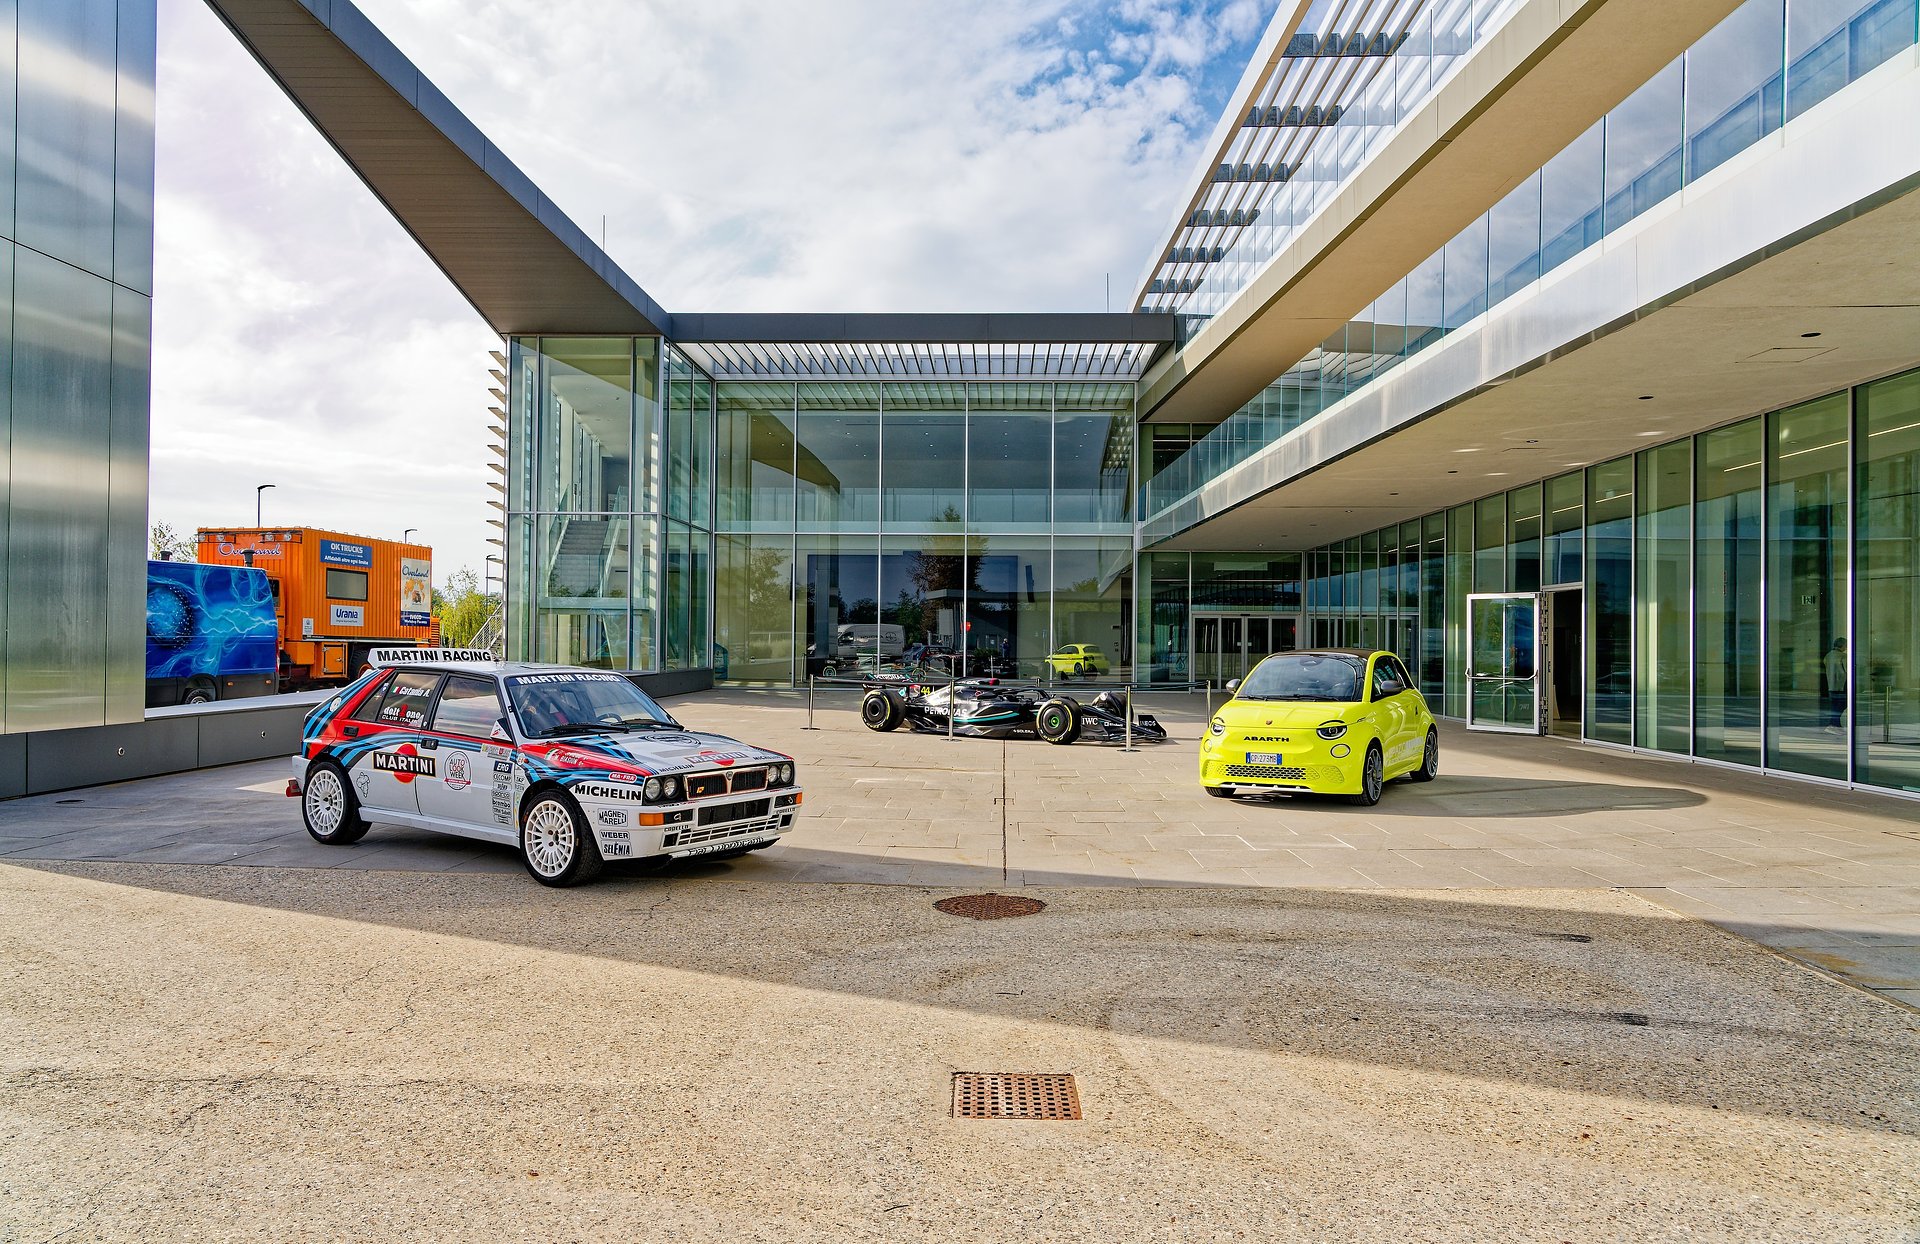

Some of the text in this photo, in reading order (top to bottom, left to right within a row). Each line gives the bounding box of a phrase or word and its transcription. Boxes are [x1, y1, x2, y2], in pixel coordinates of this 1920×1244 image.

[218, 542, 281, 557] Ovland
[330, 543, 363, 554] OK TRUCKS
[336, 608, 359, 619] Urania
[376, 650, 491, 662] MARTINI RACING
[516, 673, 621, 686] MARTINI RACING
[920, 686, 931, 696] 44
[1082, 717, 1098, 726] IWC
[449, 758, 466, 767] AUTO
[688, 751, 747, 764] MARTINI
[376, 753, 433, 774] MARTINI
[449, 764, 465, 772] LOOK
[496, 762, 510, 772] ERG
[449, 770, 465, 778] WEEK
[574, 784, 642, 801] MICHELIN
[600, 831, 629, 840] WEBER
